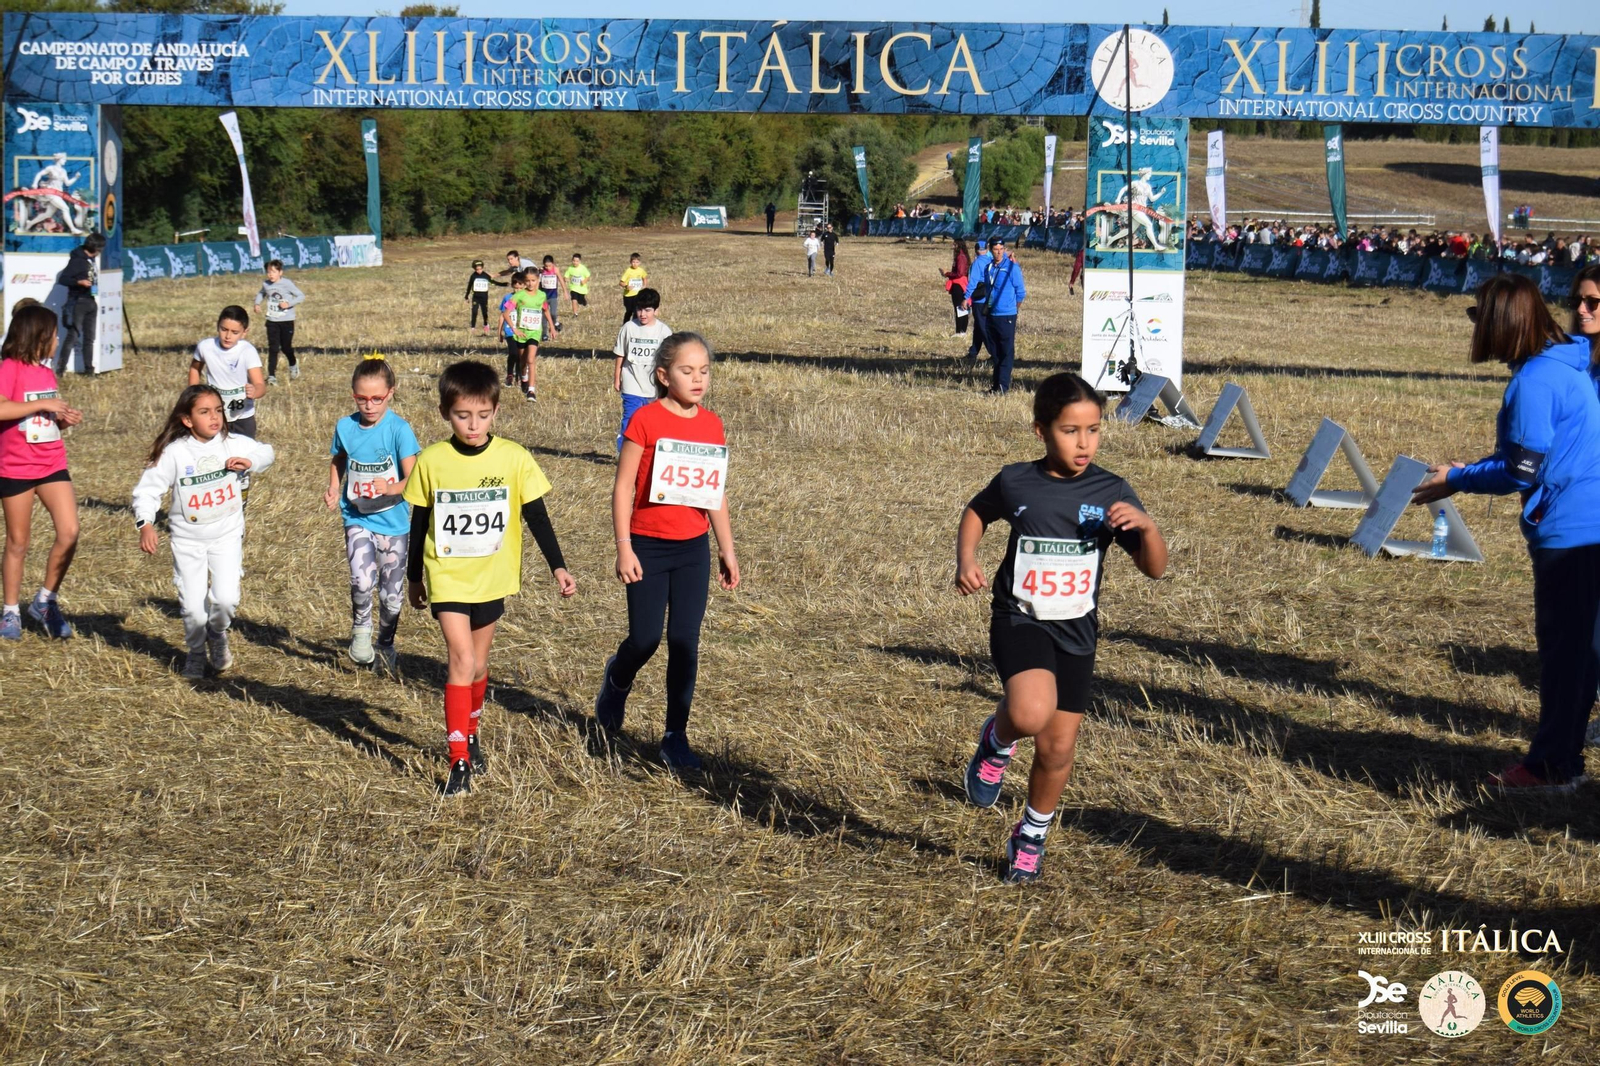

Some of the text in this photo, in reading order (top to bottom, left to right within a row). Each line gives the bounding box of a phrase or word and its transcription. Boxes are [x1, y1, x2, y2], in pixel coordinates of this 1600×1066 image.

[19, 40, 250, 58] CAMPEONATO DE ANDALUCÍA
[314, 30, 479, 86] XLIII
[482, 32, 612, 65] CROSS
[672, 20, 991, 96] ITÁLICA
[55, 56, 214, 71] DE CAMPO A TRAVÉS
[1222, 39, 1391, 98] XLIII
[1395, 44, 1528, 80] CROSS
[91, 72, 182, 86] POR CLUBES
[482, 68, 660, 87] INTERNACIONAL
[313, 90, 628, 108] INTERNATIONAL CROSS COUNTRY
[1395, 81, 1576, 103] INTERNACIONAL
[1219, 99, 1543, 124] INTERNATIONAL CROSS COUNTRY
[53, 121, 88, 132] Sevilla
[1140, 135, 1176, 146] Sevilla
[659, 464, 720, 491] 4534
[188, 483, 236, 511] 4431
[442, 511, 506, 536] 4294
[1039, 541, 1081, 555] ITÁLICA
[1021, 569, 1092, 597] 4533
